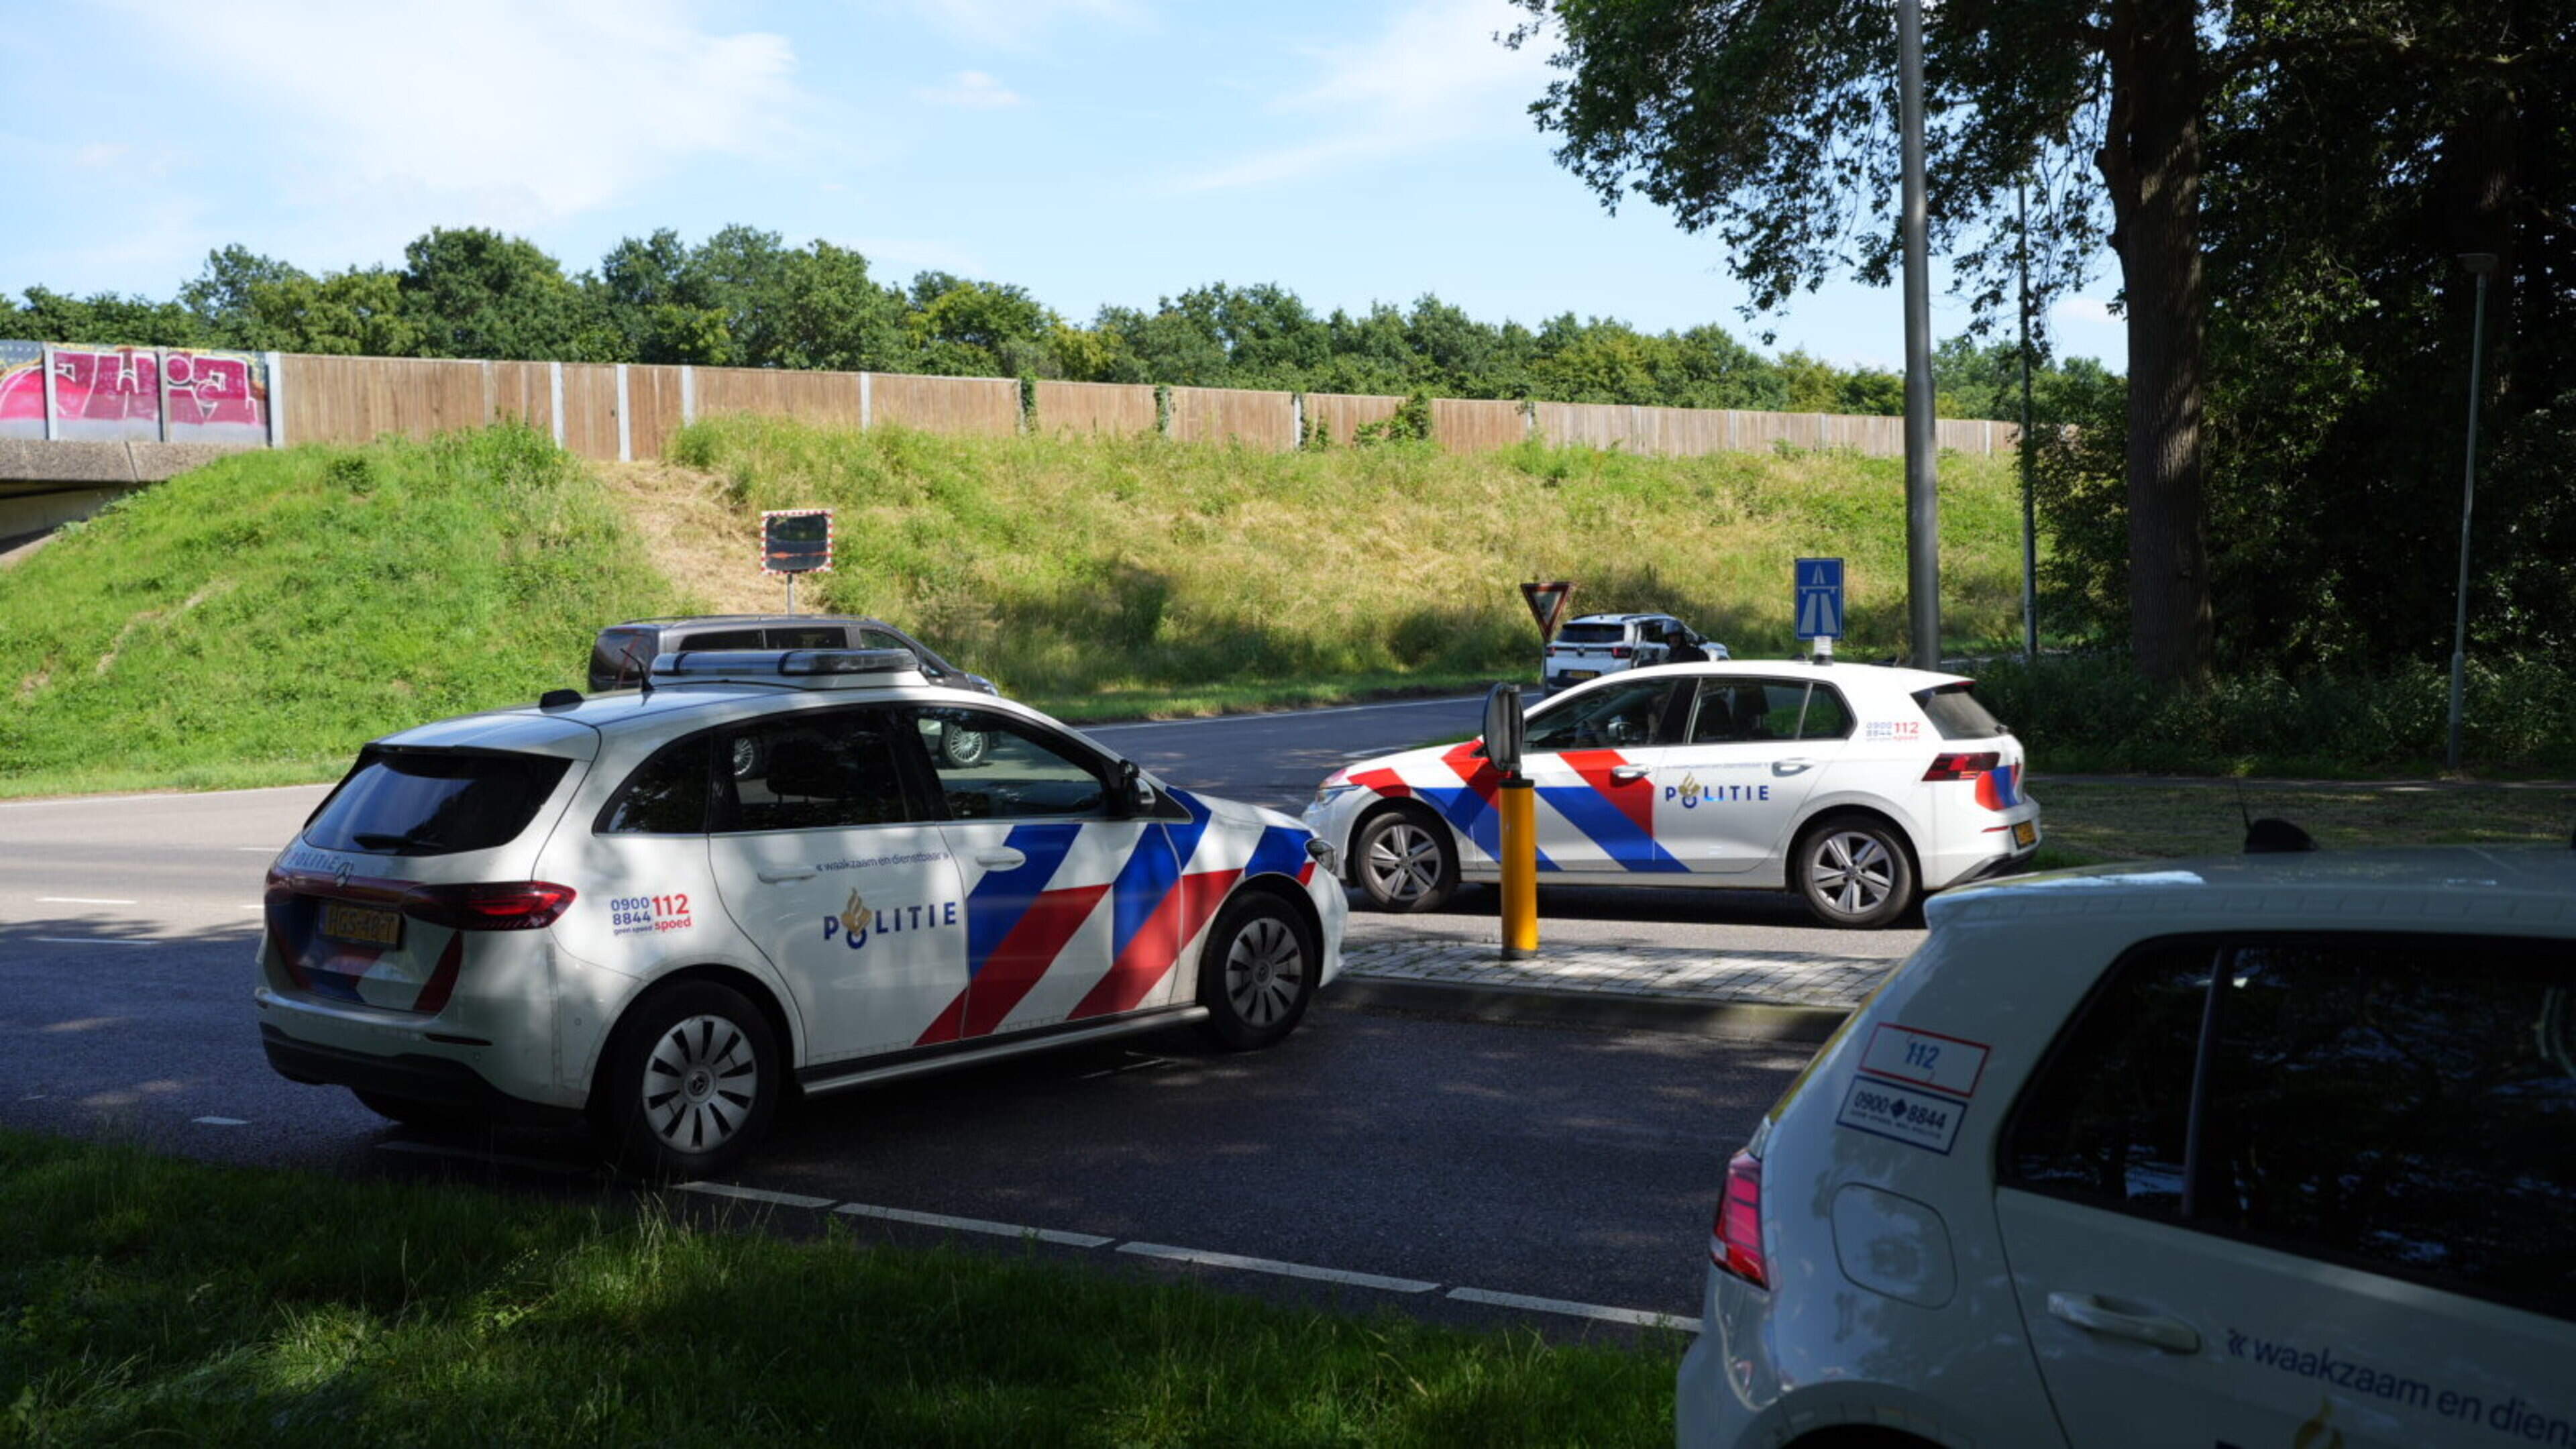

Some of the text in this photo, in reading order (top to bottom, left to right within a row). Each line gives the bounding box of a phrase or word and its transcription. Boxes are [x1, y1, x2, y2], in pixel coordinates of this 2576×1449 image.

[1894, 722, 1919, 733] 112
[1665, 785, 1770, 809] POLITIE
[611, 897, 649, 911] 0900
[651, 894, 690, 916] 112
[613, 911, 651, 925] 8844
[654, 916, 692, 932] spoed
[824, 902, 957, 949] POLITIE
[1906, 1042, 1939, 1069] 112
[1854, 1091, 1889, 1114] 0900
[1907, 1104, 1947, 1130] 8844
[2254, 1339, 2576, 1449] waakzaam en dien
